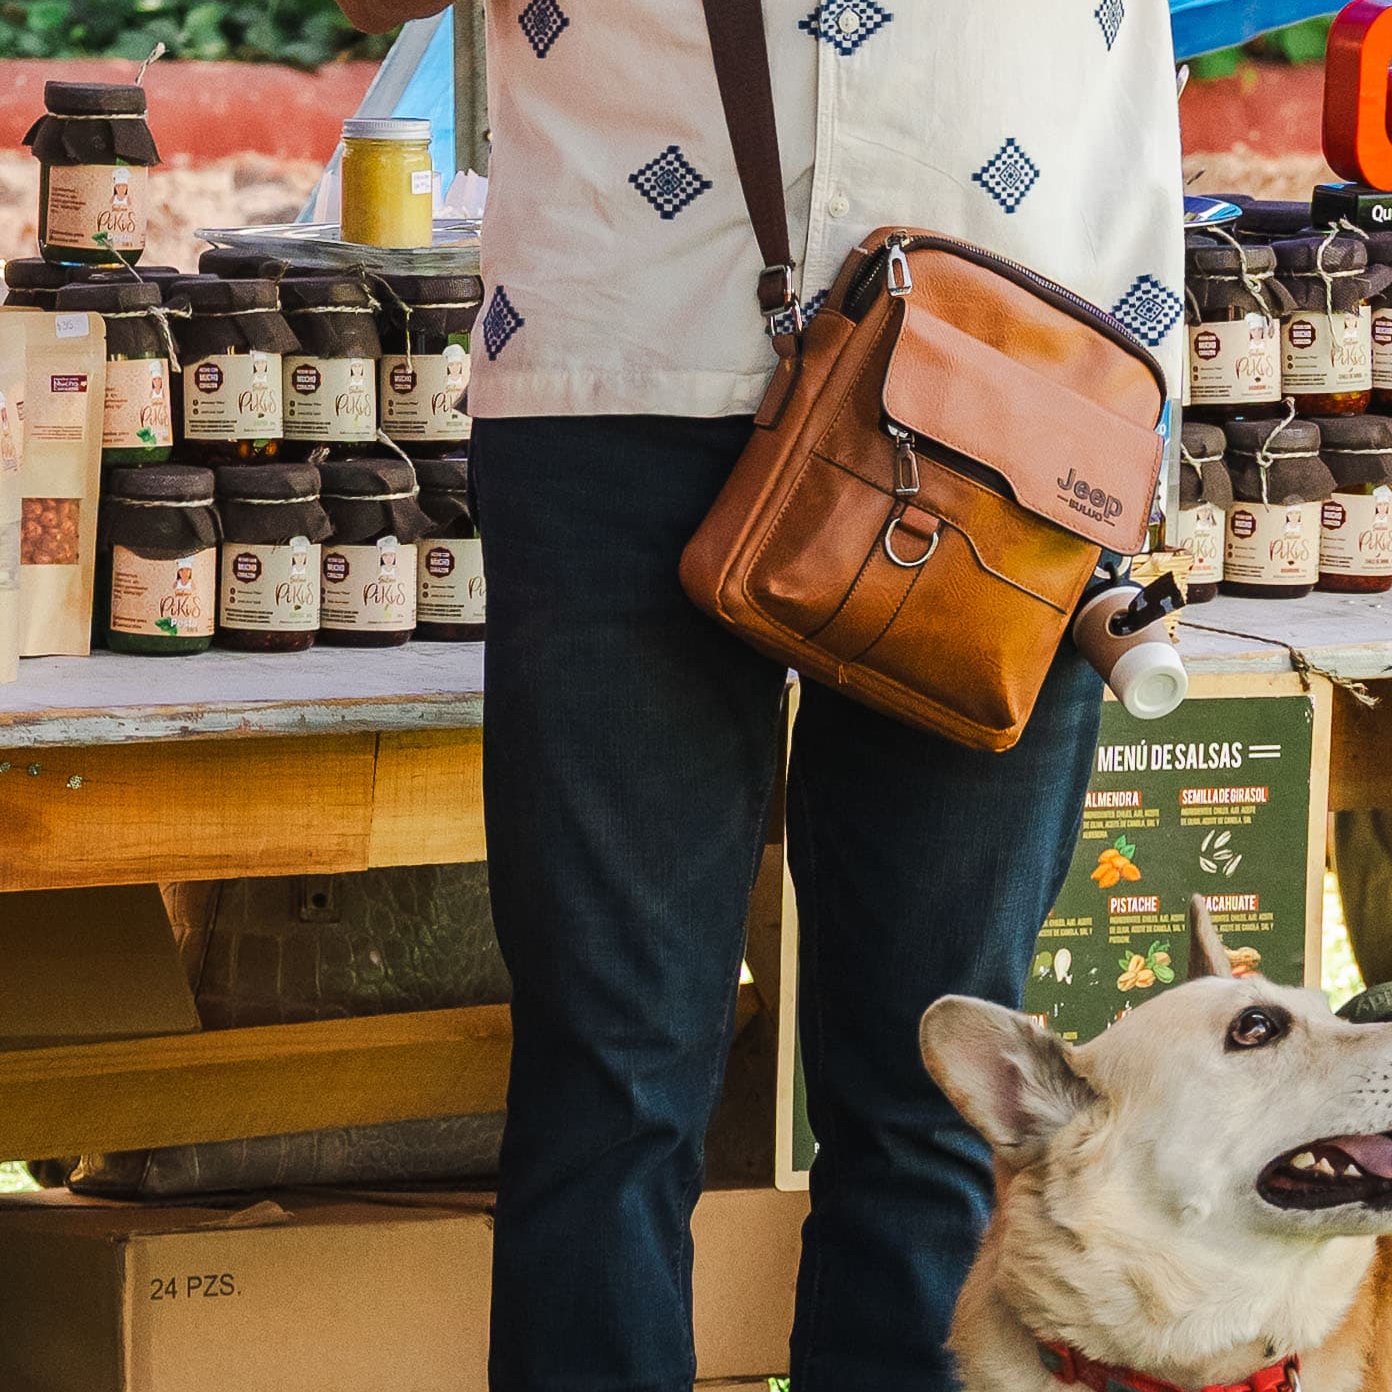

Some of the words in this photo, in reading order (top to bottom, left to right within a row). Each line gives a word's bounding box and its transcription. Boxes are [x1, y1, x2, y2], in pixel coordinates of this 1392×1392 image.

[1057, 468, 1123, 519] Jeep
[1098, 739, 1147, 772] MENÚ
[1151, 744, 1173, 770] DE
[1175, 741, 1242, 769] SALSAS
[1084, 791, 1140, 808] ALMENDRA
[1110, 896, 1158, 913] PISTACHE
[150, 1278, 178, 1300] 24
[186, 1274, 243, 1298] PZS.
